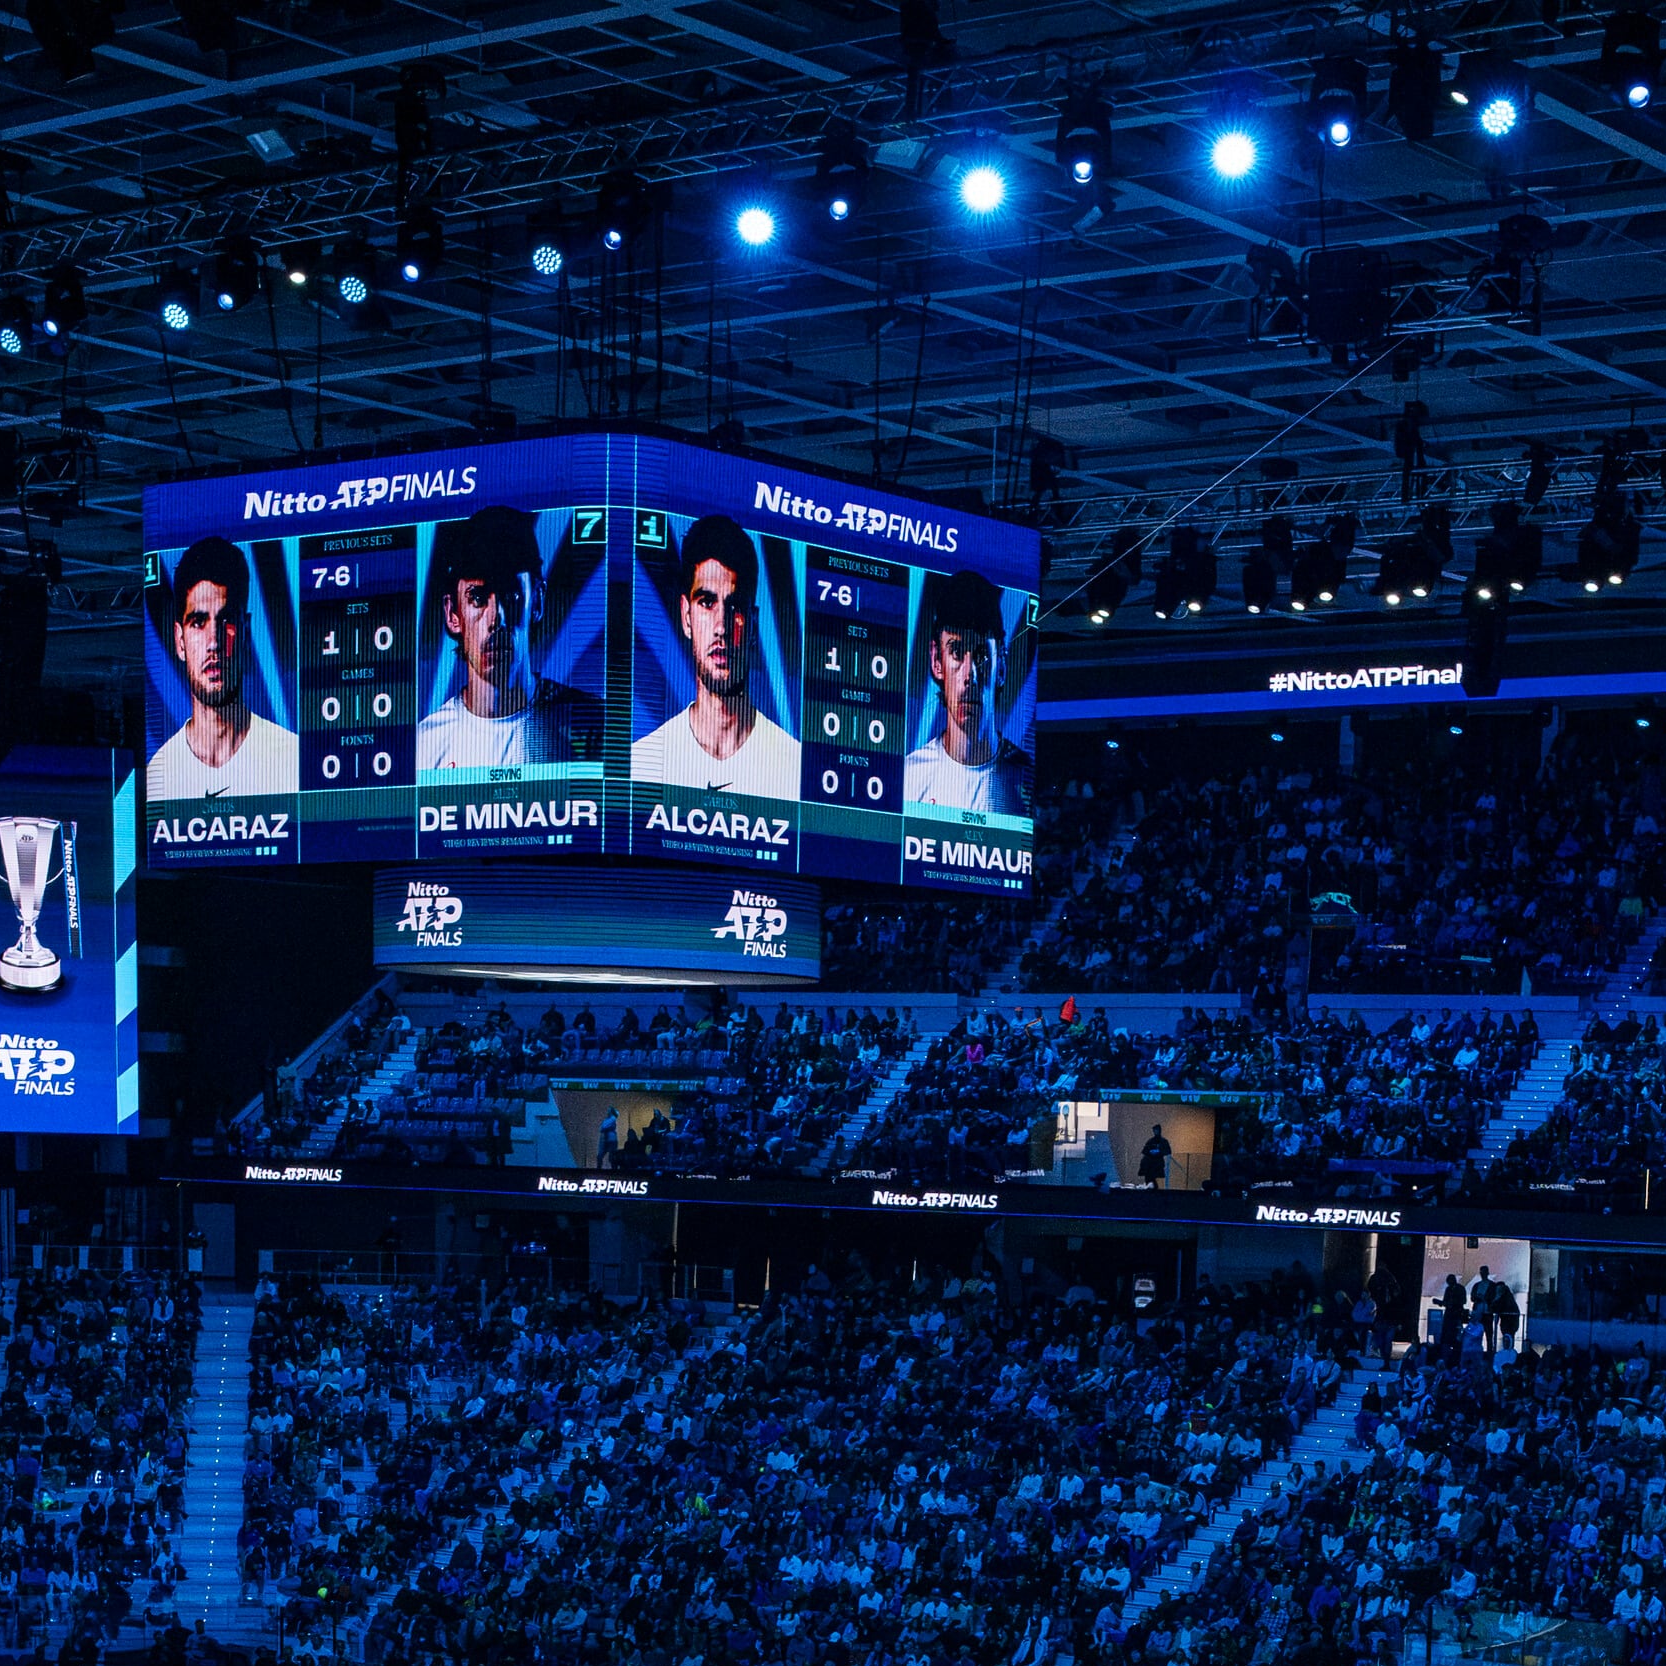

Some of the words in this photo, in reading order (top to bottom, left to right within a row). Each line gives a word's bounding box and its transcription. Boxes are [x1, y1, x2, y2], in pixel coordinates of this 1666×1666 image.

[244, 491, 326, 520] Nitto
[388, 466, 477, 503] FINALS
[575, 511, 604, 539] 7
[639, 515, 664, 543] 1
[753, 481, 832, 524] Nitto
[885, 512, 960, 554] FINALS
[368, 534, 393, 547] SETS
[311, 565, 351, 589] 7-6
[868, 565, 890, 579] SETS
[816, 579, 853, 607] 7-6
[346, 602, 369, 615] SETS
[322, 630, 340, 655] 1
[374, 625, 394, 651] 0
[847, 624, 868, 640] SETS
[341, 667, 375, 681] GAMES
[824, 647, 841, 672] 1
[870, 654, 888, 680] 0
[1269, 663, 1463, 693] #NittoATPFinal
[321, 696, 341, 722] 0
[372, 693, 392, 718] 0
[340, 733, 374, 747] POINTS
[822, 711, 841, 737] 0
[868, 719, 885, 744] 0
[321, 754, 341, 780] 0
[372, 751, 392, 777] 0
[839, 753, 869, 768] POINTS
[489, 768, 522, 782] SERVING
[821, 769, 839, 794] 0
[866, 775, 884, 801] 0
[152, 813, 290, 844] ALCARAZ
[419, 805, 459, 832] DE
[465, 799, 599, 831] MINAUR
[644, 803, 790, 846] ALCARAZ
[961, 811, 987, 826] SERVING
[904, 834, 937, 864] DE
[941, 840, 1033, 876] MINAUR
[406, 881, 450, 897] Nitto
[731, 890, 778, 909] Nitto
[395, 896, 463, 932] ATP
[709, 905, 788, 942] ATP
[416, 930, 463, 947] FINALS
[743, 939, 787, 959] FINALS
[13, 1080, 76, 1097] FINALS
[537, 1176, 579, 1192] Nitto
[609, 1179, 649, 1195] FINALS
[1255, 1204, 1310, 1223] Nitto
[1349, 1209, 1401, 1227] FINALS
